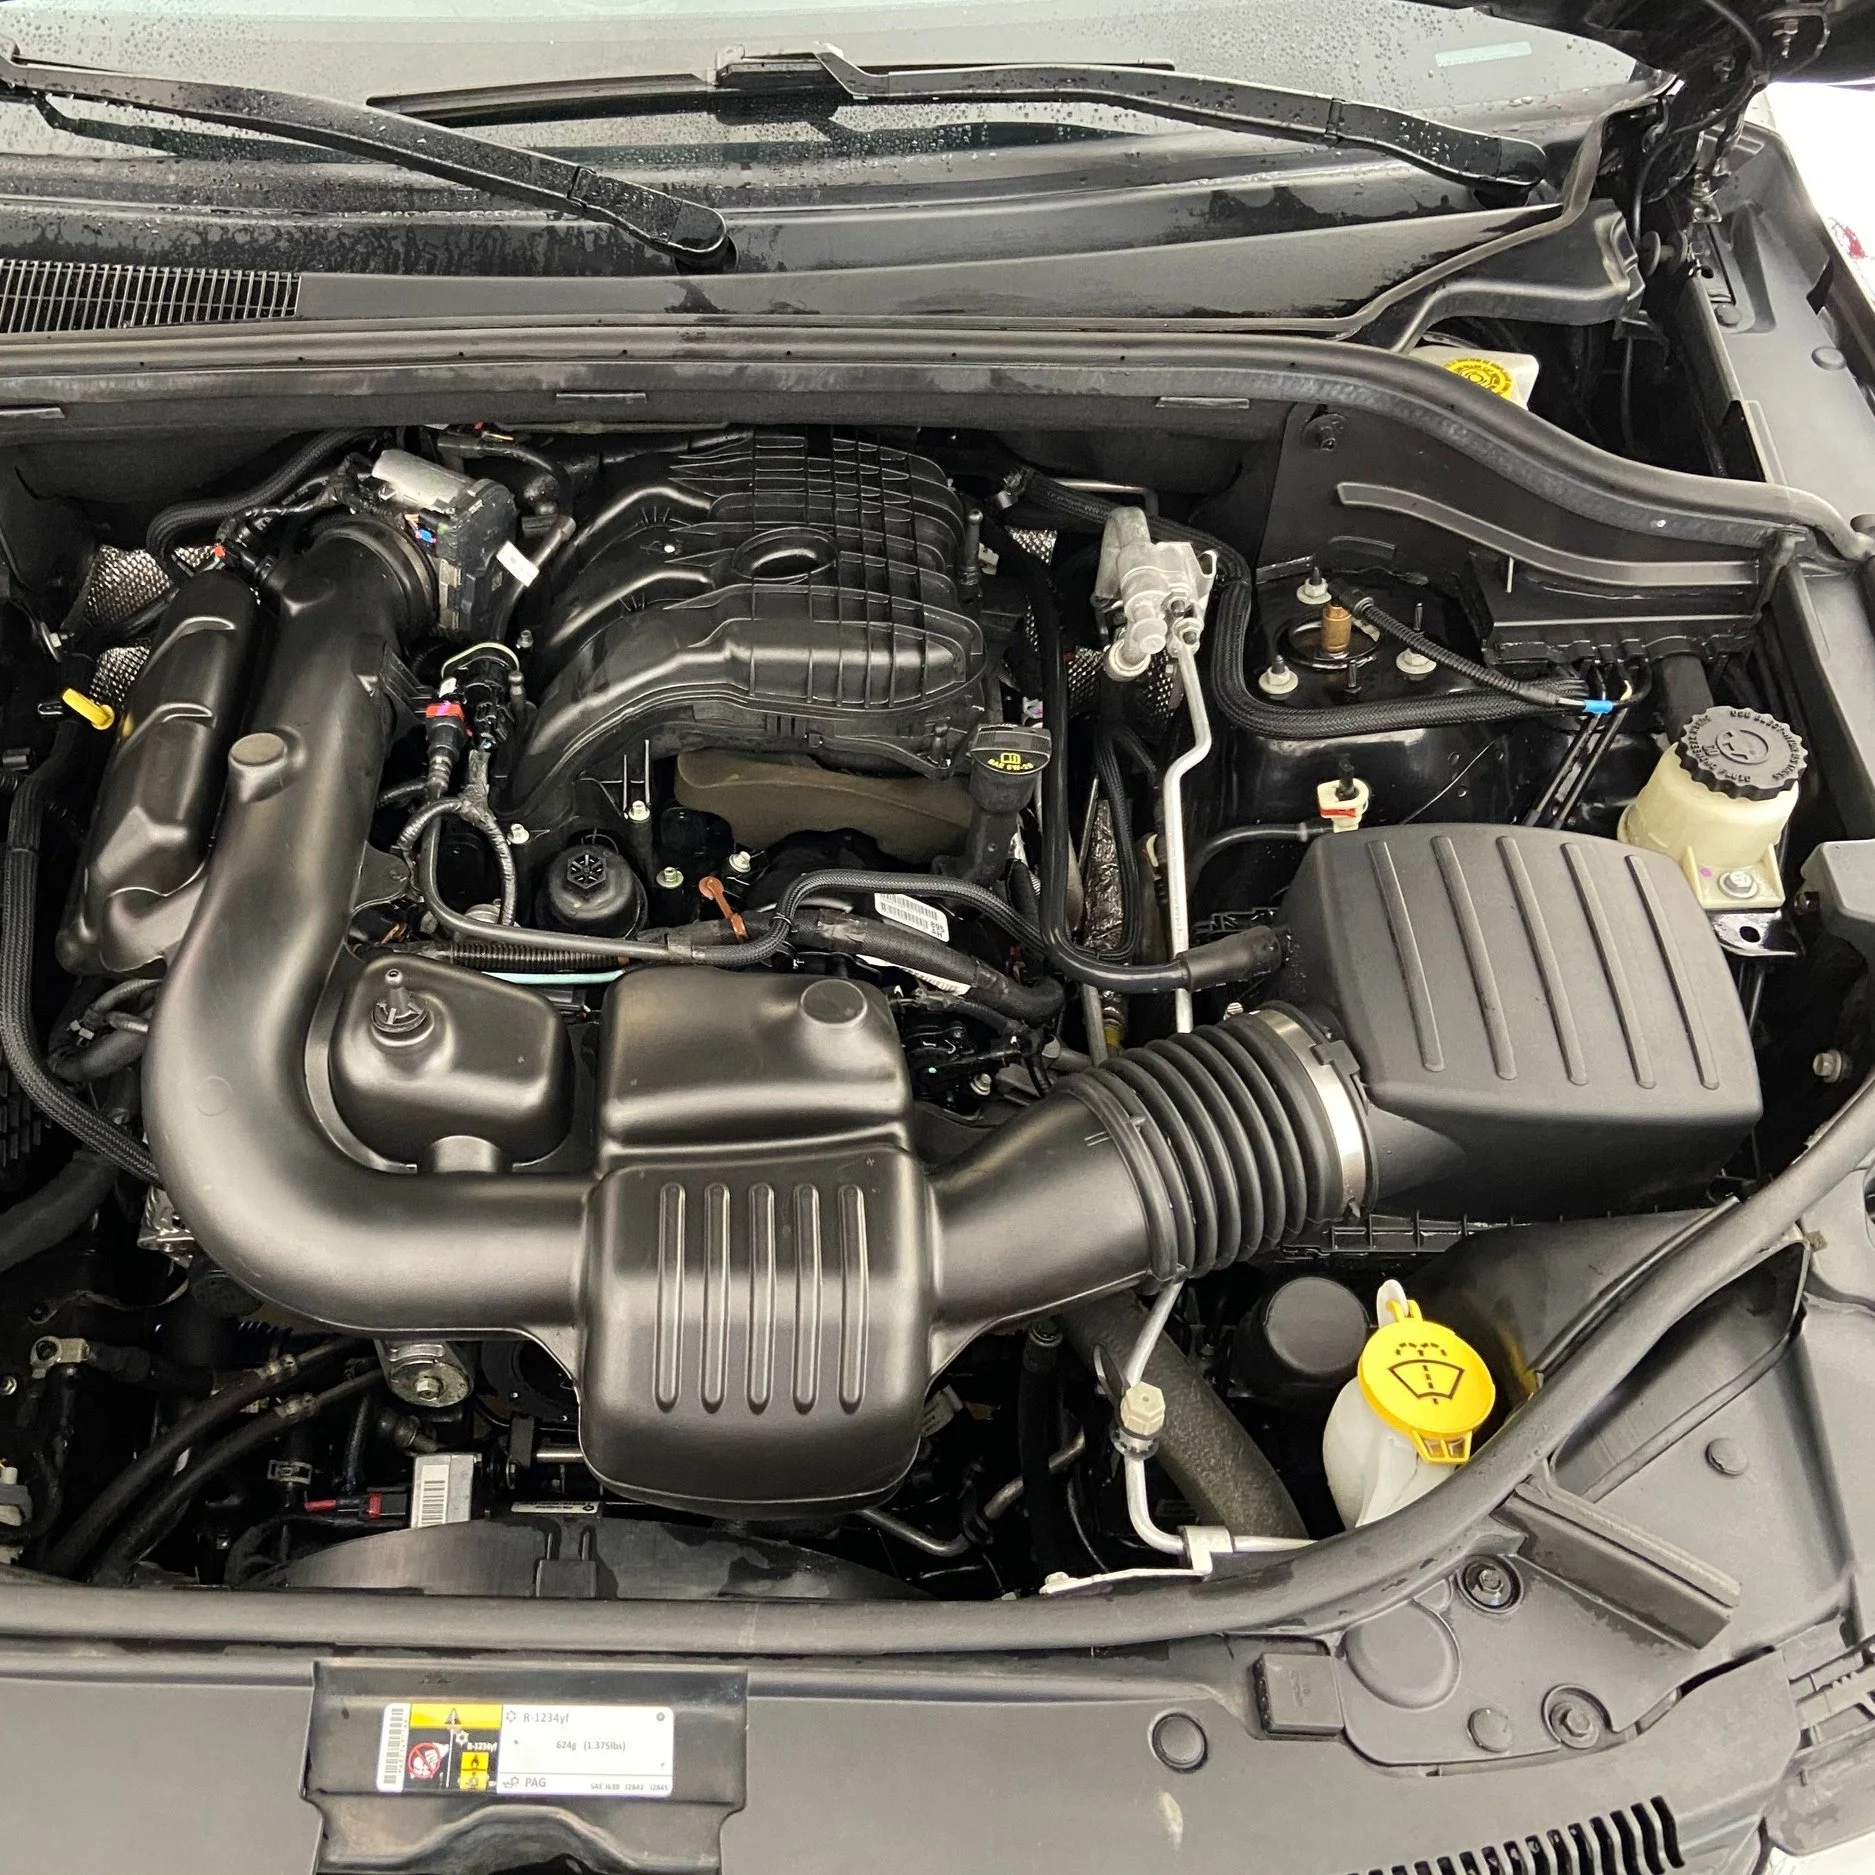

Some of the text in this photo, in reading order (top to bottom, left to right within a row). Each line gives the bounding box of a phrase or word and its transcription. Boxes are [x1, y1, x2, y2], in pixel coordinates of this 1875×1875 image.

[523, 1712, 569, 1724] R-1234yf
[556, 1740, 626, 1751] 624g (1.375lbs)
[525, 1777, 546, 1787] PAG
